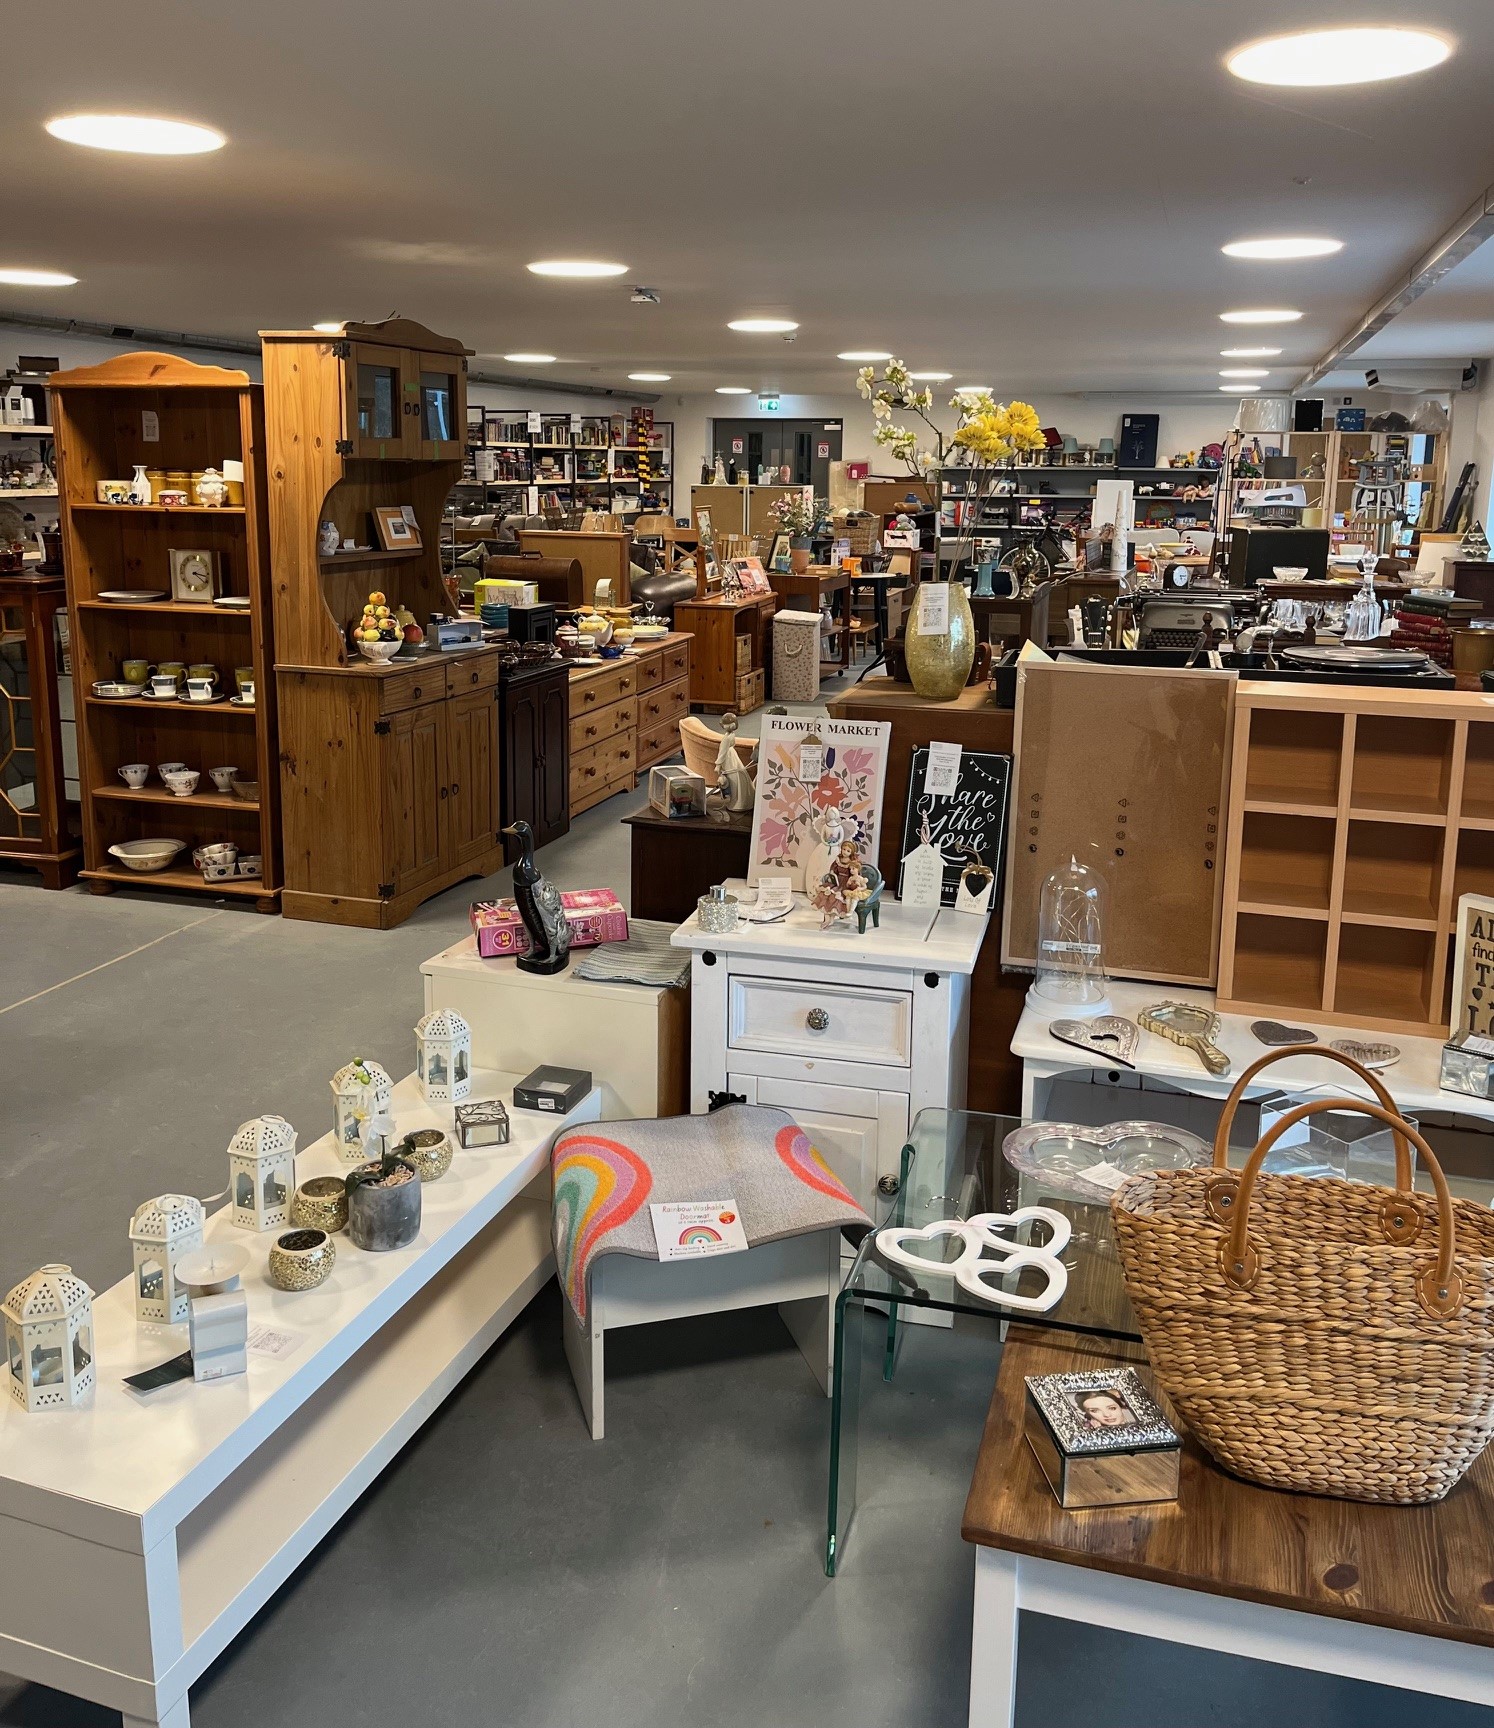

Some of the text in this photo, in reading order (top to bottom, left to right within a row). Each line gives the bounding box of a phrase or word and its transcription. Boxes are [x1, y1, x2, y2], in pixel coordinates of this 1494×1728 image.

[771, 720, 881, 737] FLOWER MARKET
[948, 805, 986, 831] the
[1475, 962, 1494, 989] T
[662, 1203, 726, 1213] Rainbow Washable
[680, 1213, 710, 1221] Doormat
